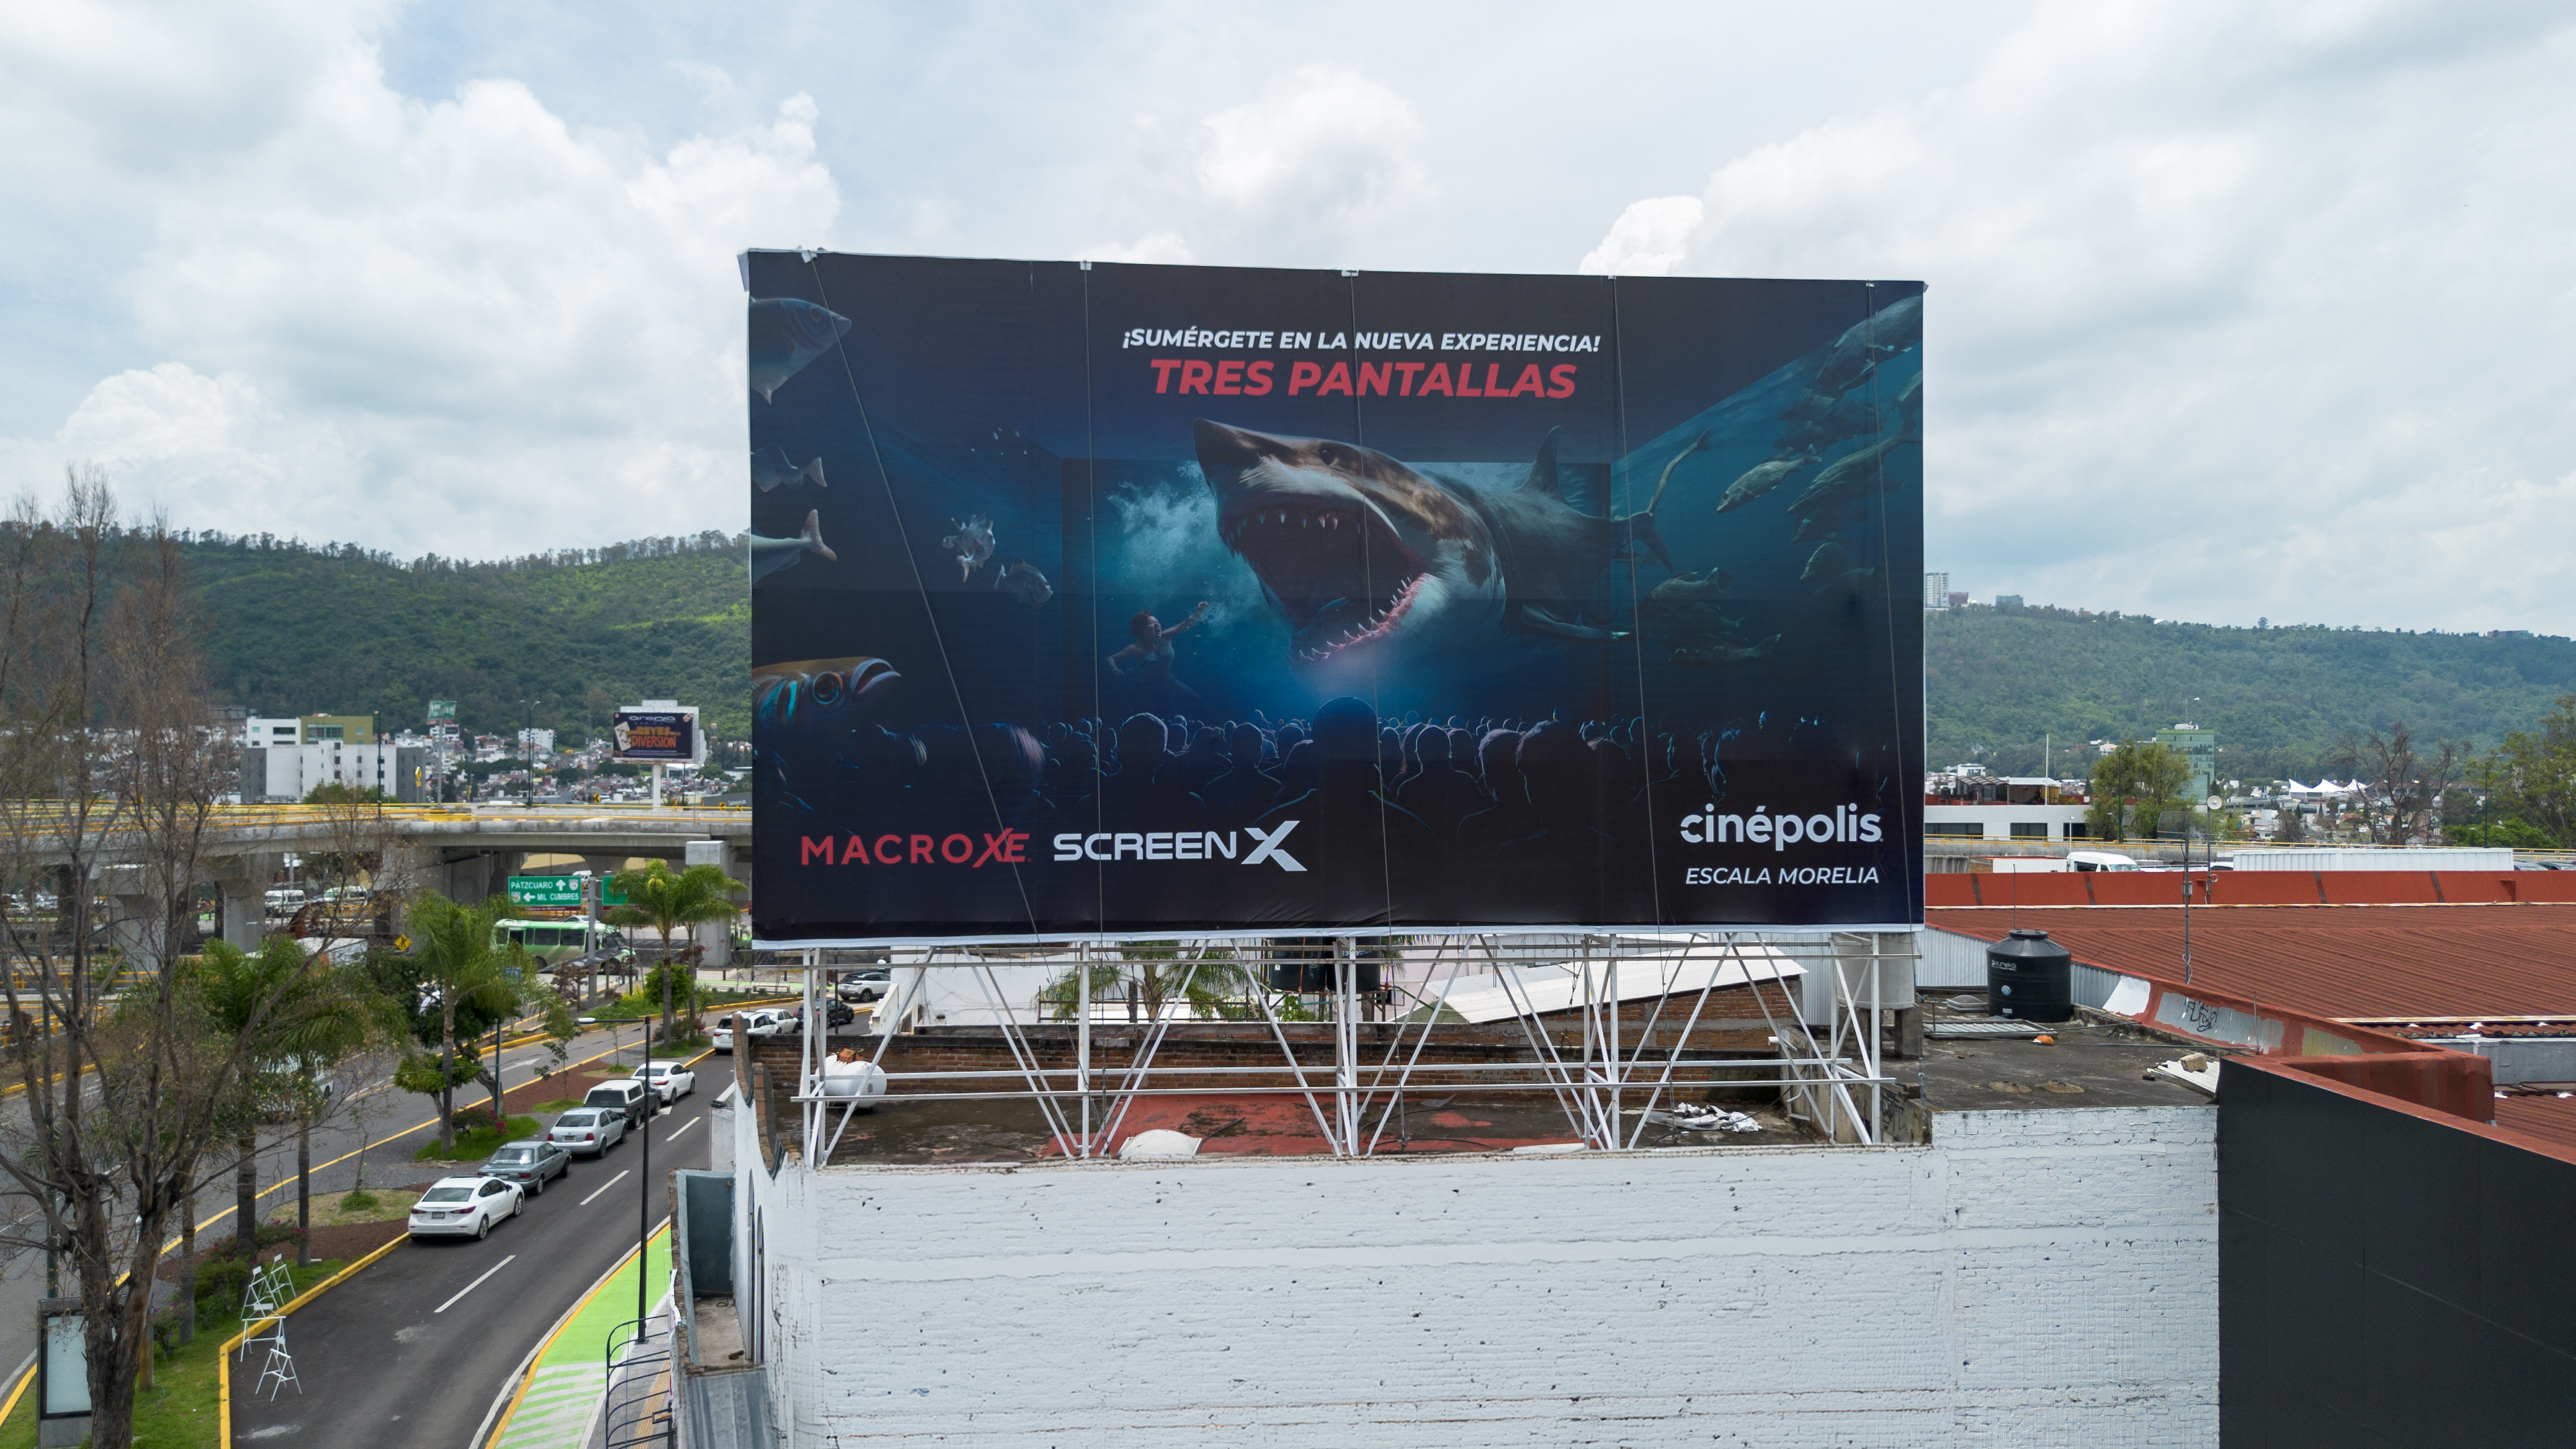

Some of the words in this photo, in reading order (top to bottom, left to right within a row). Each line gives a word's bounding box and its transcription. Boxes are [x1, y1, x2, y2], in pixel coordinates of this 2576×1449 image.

[1122, 325, 1274, 350] ¡SUMÉRGETE
[1279, 332, 1312, 349] EN
[1318, 332, 1347, 349] LA
[1354, 332, 1435, 351] NUEVA
[1440, 333, 1601, 353] EXPERIENCIA!
[1150, 359, 1274, 395] TRES
[1288, 361, 1577, 399] PANTALLAS
[1680, 802, 1882, 851] cinépolis
[511, 880, 553, 889] PÁTZCUARO
[1685, 867, 1772, 885] ESCALA
[1778, 867, 1879, 885] MORELIA
